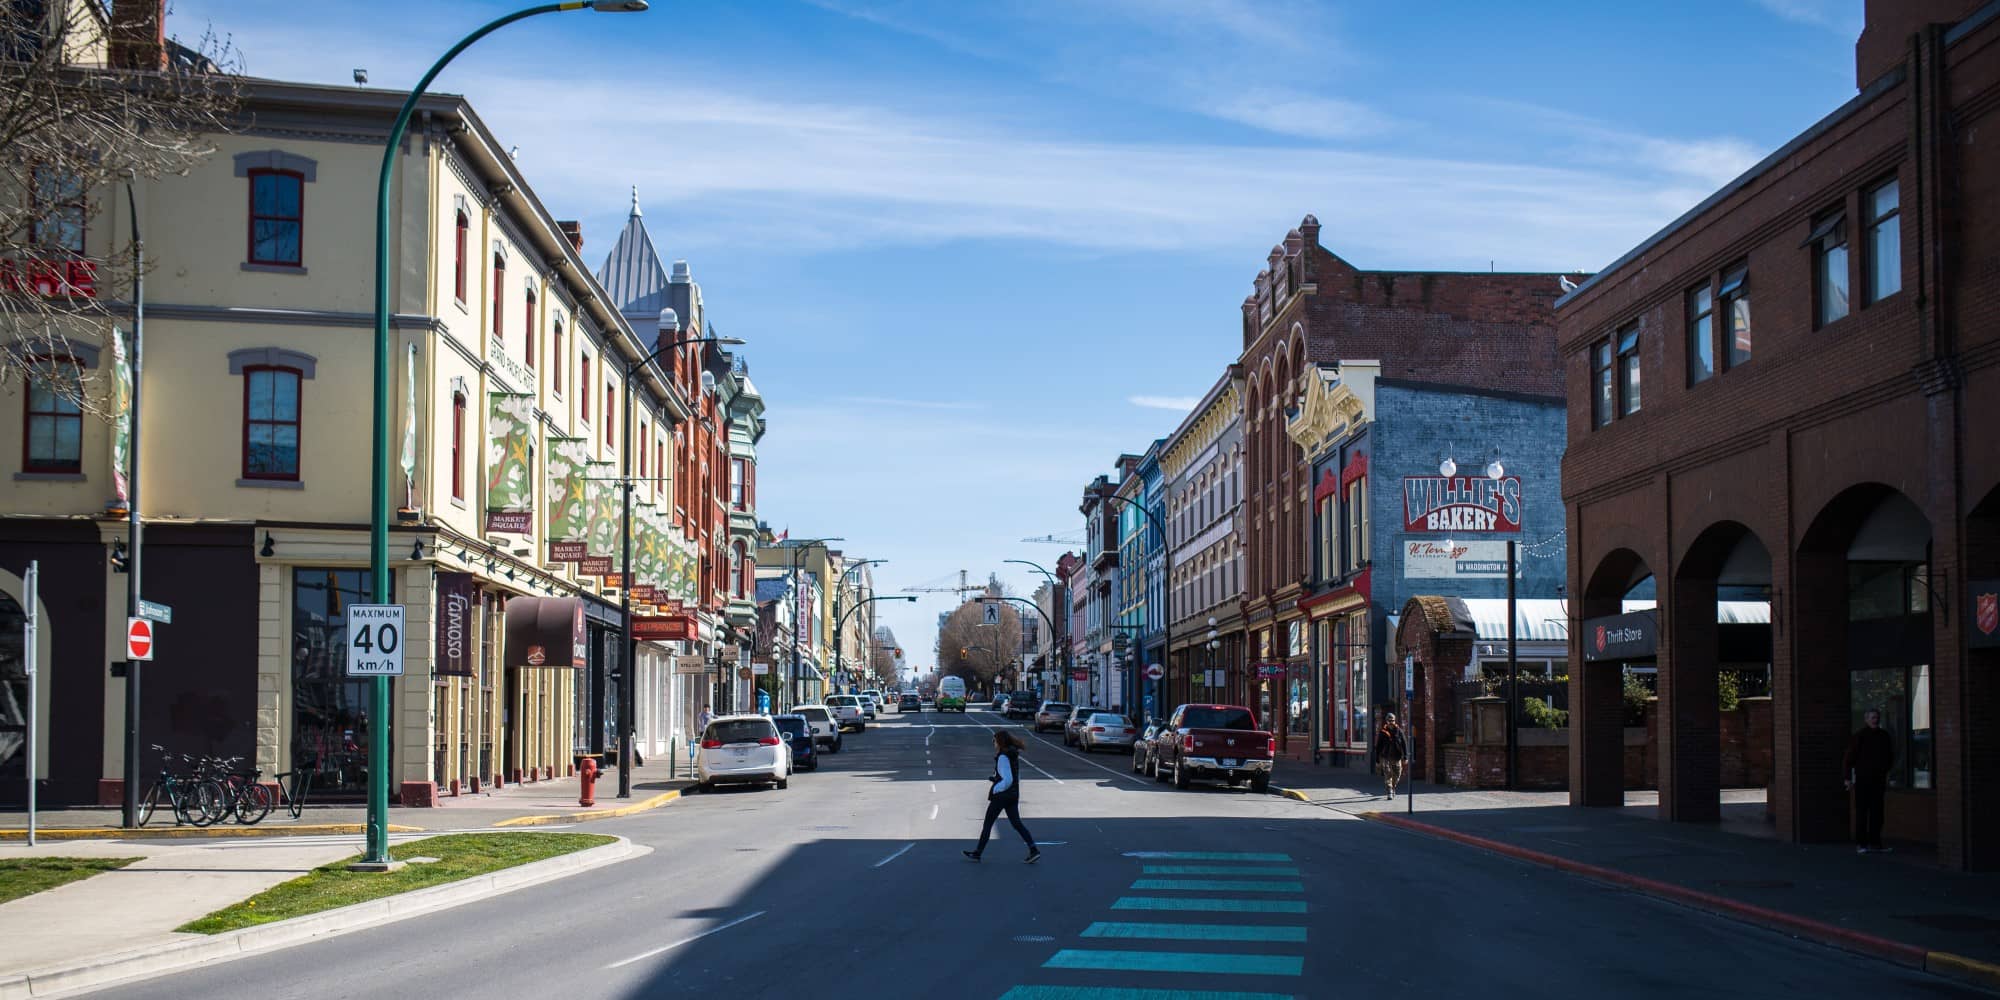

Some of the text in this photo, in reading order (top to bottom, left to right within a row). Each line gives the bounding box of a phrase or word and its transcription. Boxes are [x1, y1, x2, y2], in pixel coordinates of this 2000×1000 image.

[1404, 477, 1520, 526] WILLIE'S
[1426, 506, 1498, 531] BAKERY
[1457, 563, 1464, 571] IN
[353, 609, 400, 619] MAXIMUM
[634, 623, 681, 632] ENTRANCE
[353, 623, 398, 654] 40
[1606, 628, 1623, 644] Thrift
[1624, 628, 1642, 642] Store
[357, 658, 394, 671] km/h
